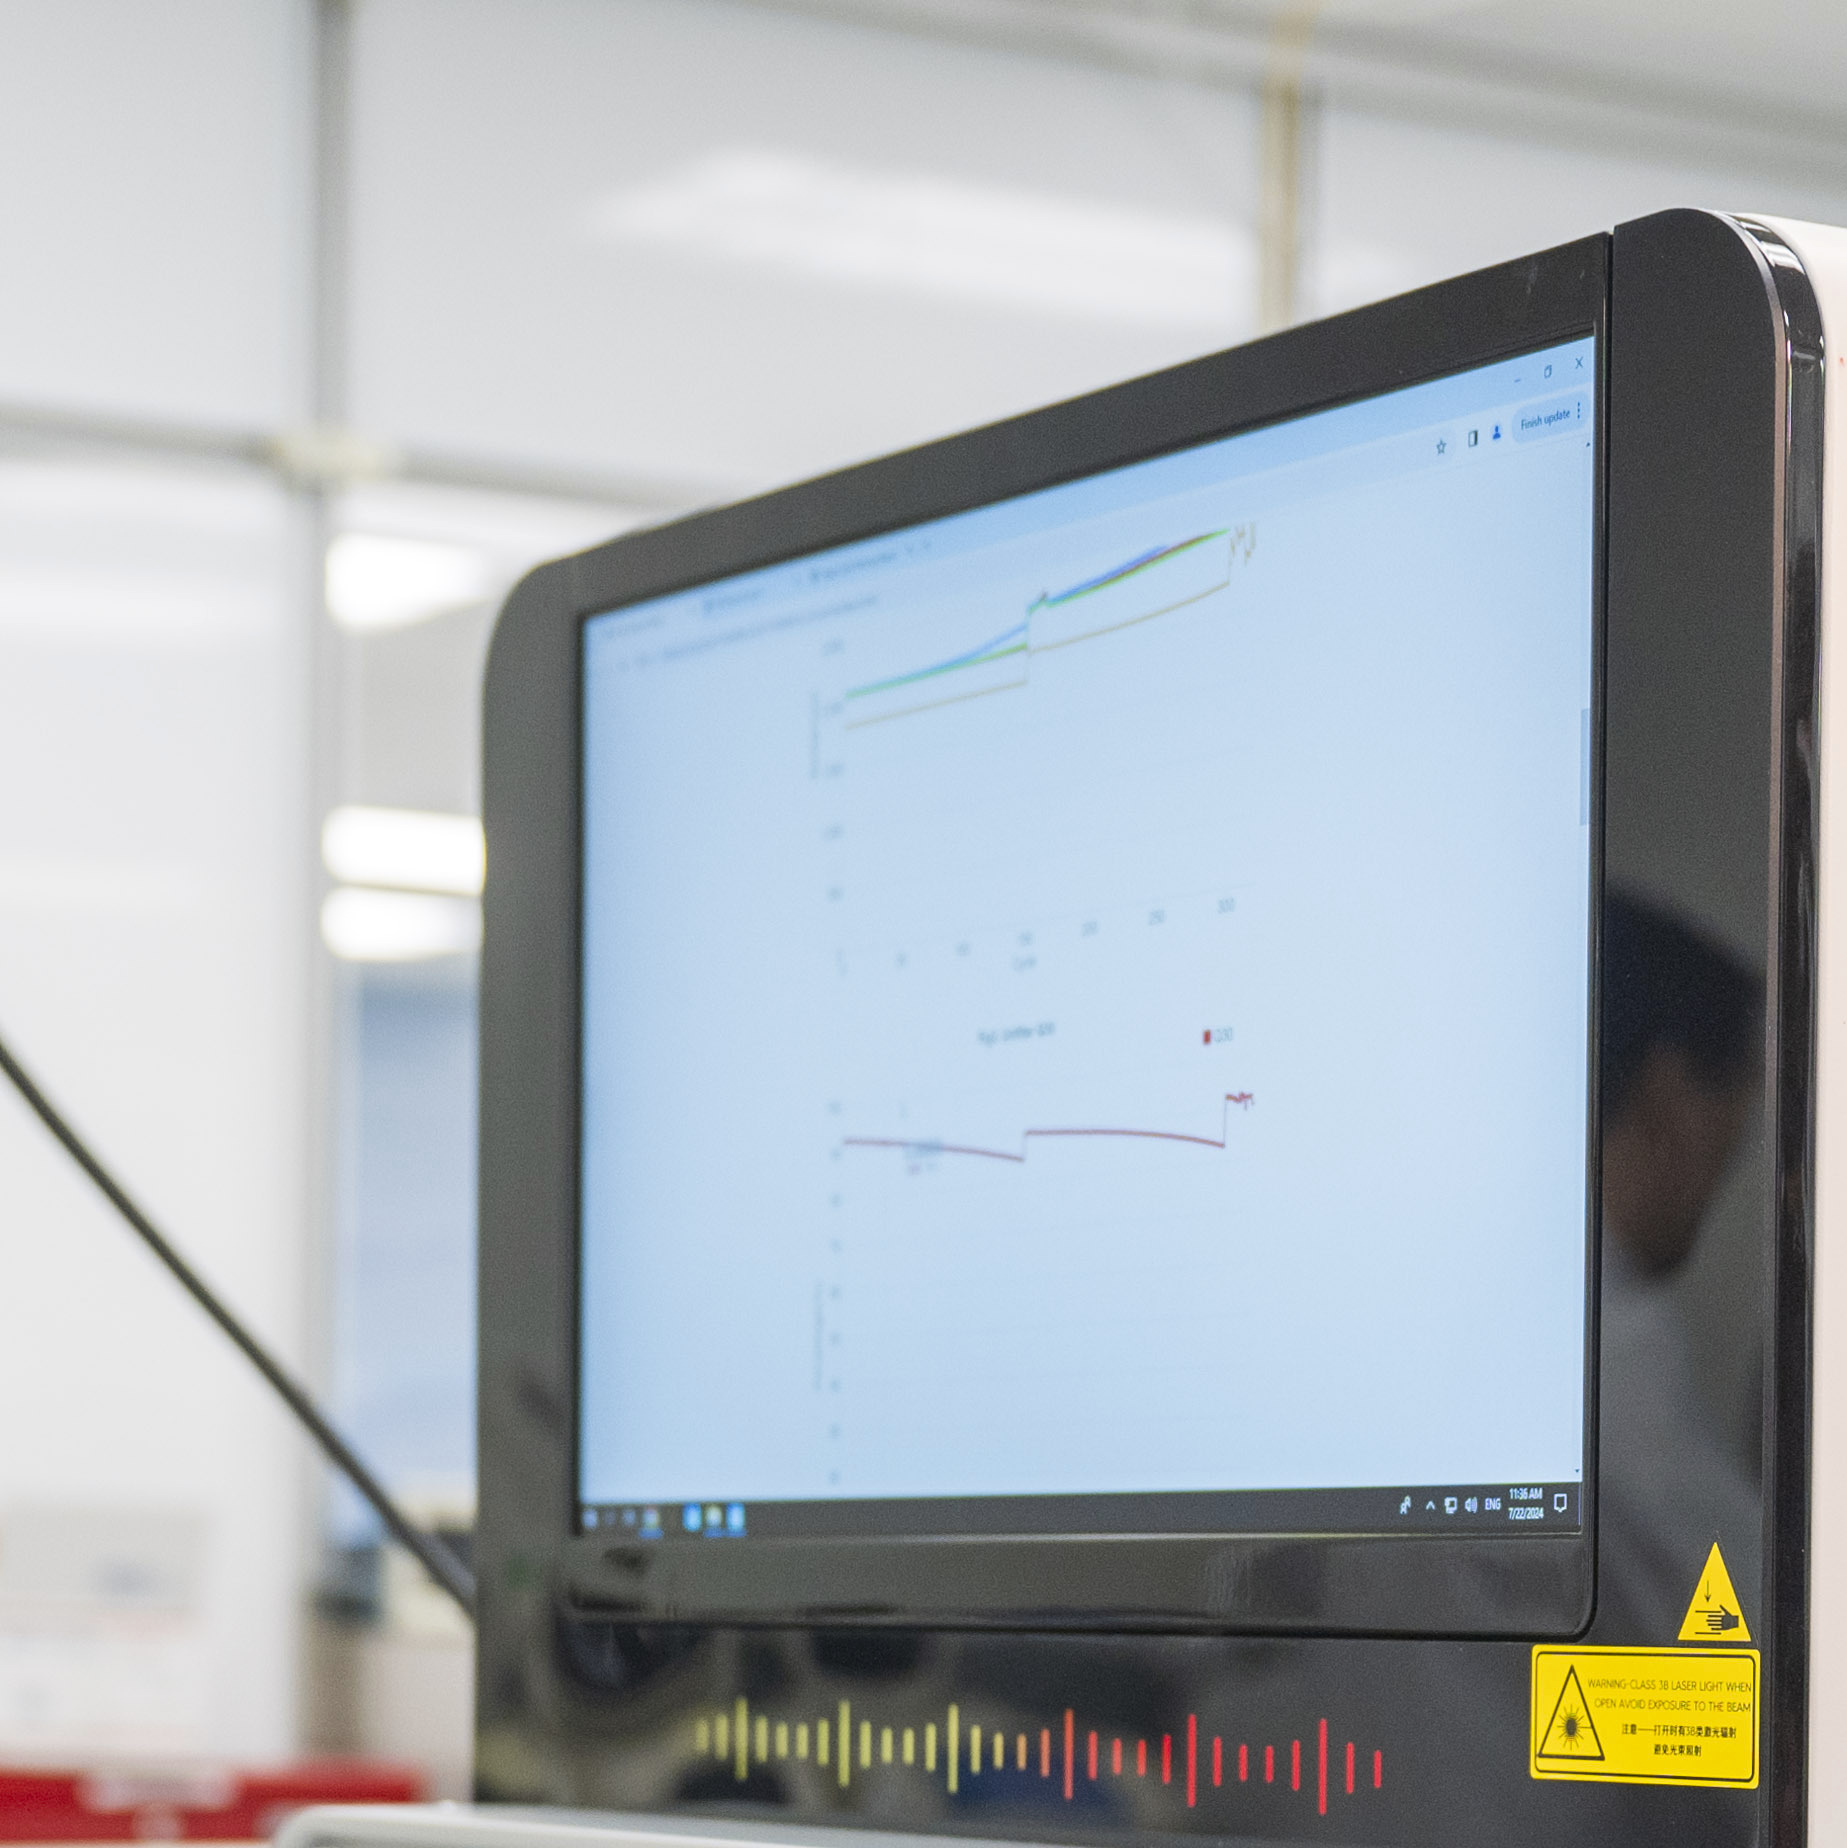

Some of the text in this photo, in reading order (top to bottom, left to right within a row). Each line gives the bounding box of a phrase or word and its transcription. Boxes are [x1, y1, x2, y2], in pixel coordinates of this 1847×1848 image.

[1520, 409, 1571, 431] Finish update
[1529, 1488, 1543, 1500] AM
[1484, 1498, 1501, 1510] ENG
[1671, 1680, 1697, 1691] LASER
[1699, 1681, 1724, 1692] LIGHT
[1726, 1682, 1752, 1693] WHEN
[1594, 1698, 1751, 1713] OPEN AVOID EXPOSURE TO THE BEAM
